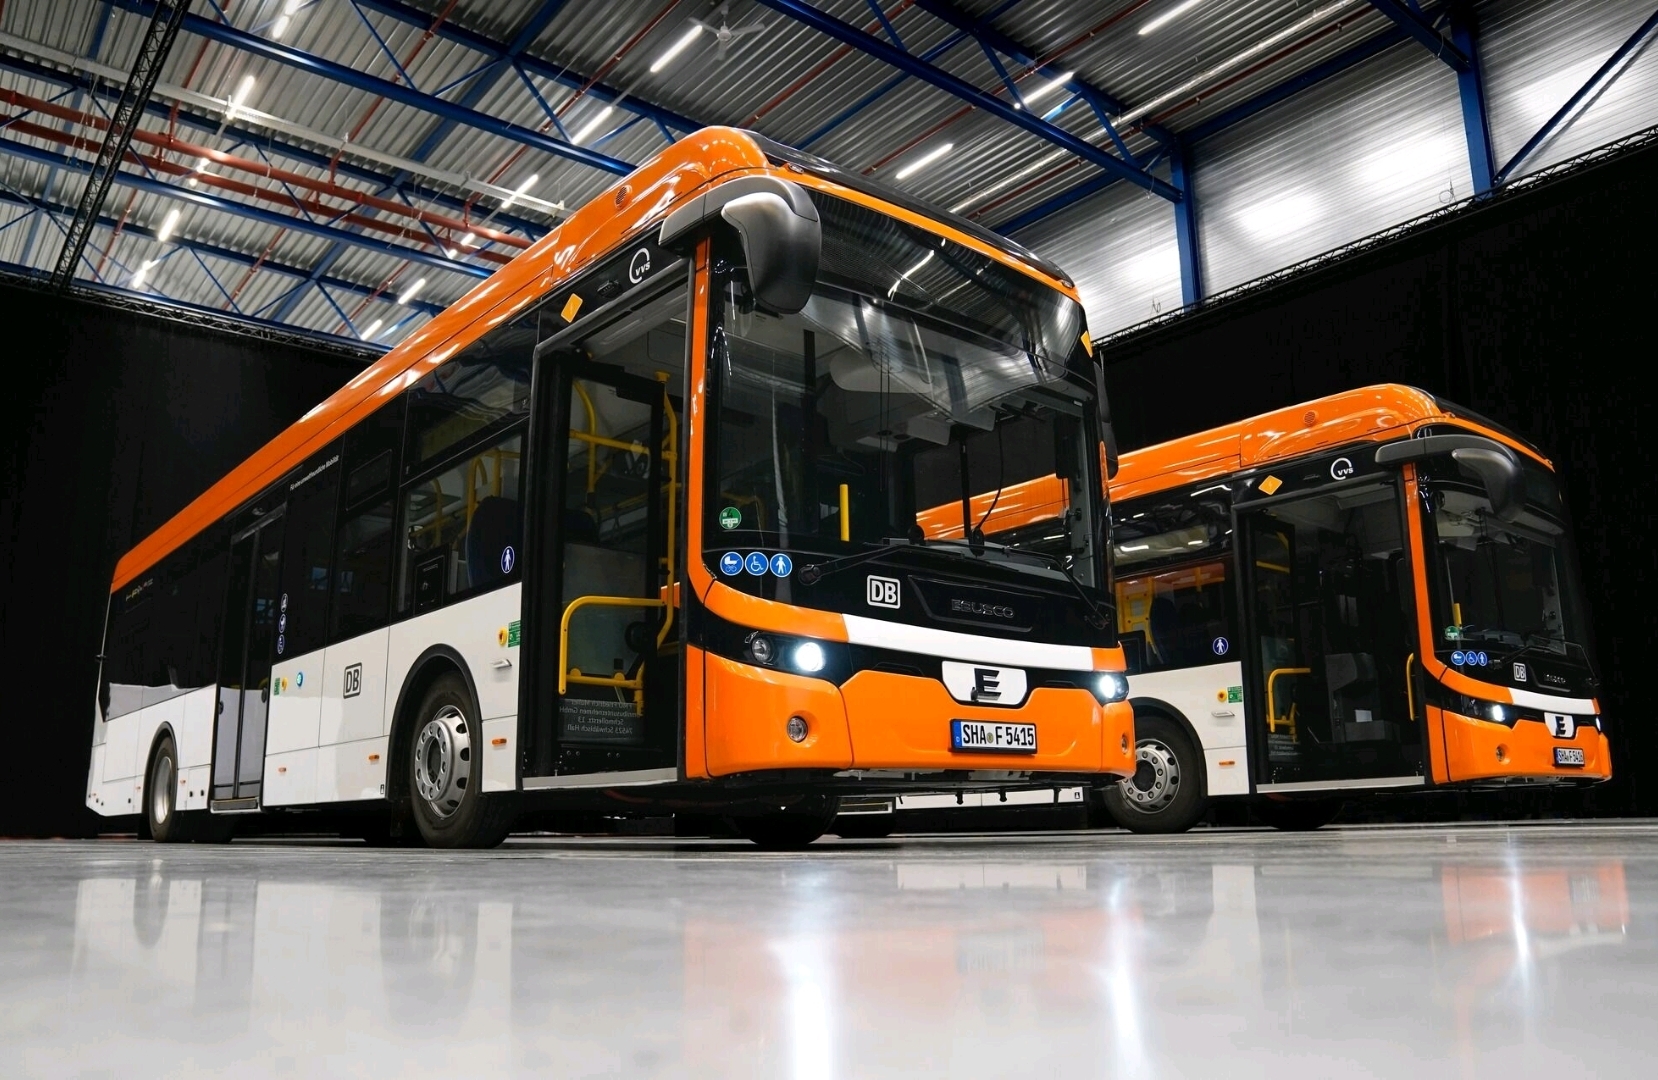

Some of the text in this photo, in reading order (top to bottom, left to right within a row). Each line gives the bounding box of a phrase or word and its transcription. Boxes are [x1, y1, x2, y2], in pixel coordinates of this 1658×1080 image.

[871, 580, 897, 603] DB
[345, 668, 360, 694] DB
[1515, 665, 1525, 680] DB
[974, 668, 1002, 700] E
[963, 724, 1034, 746] SHA F 5415
[1555, 715, 1567, 736] E
